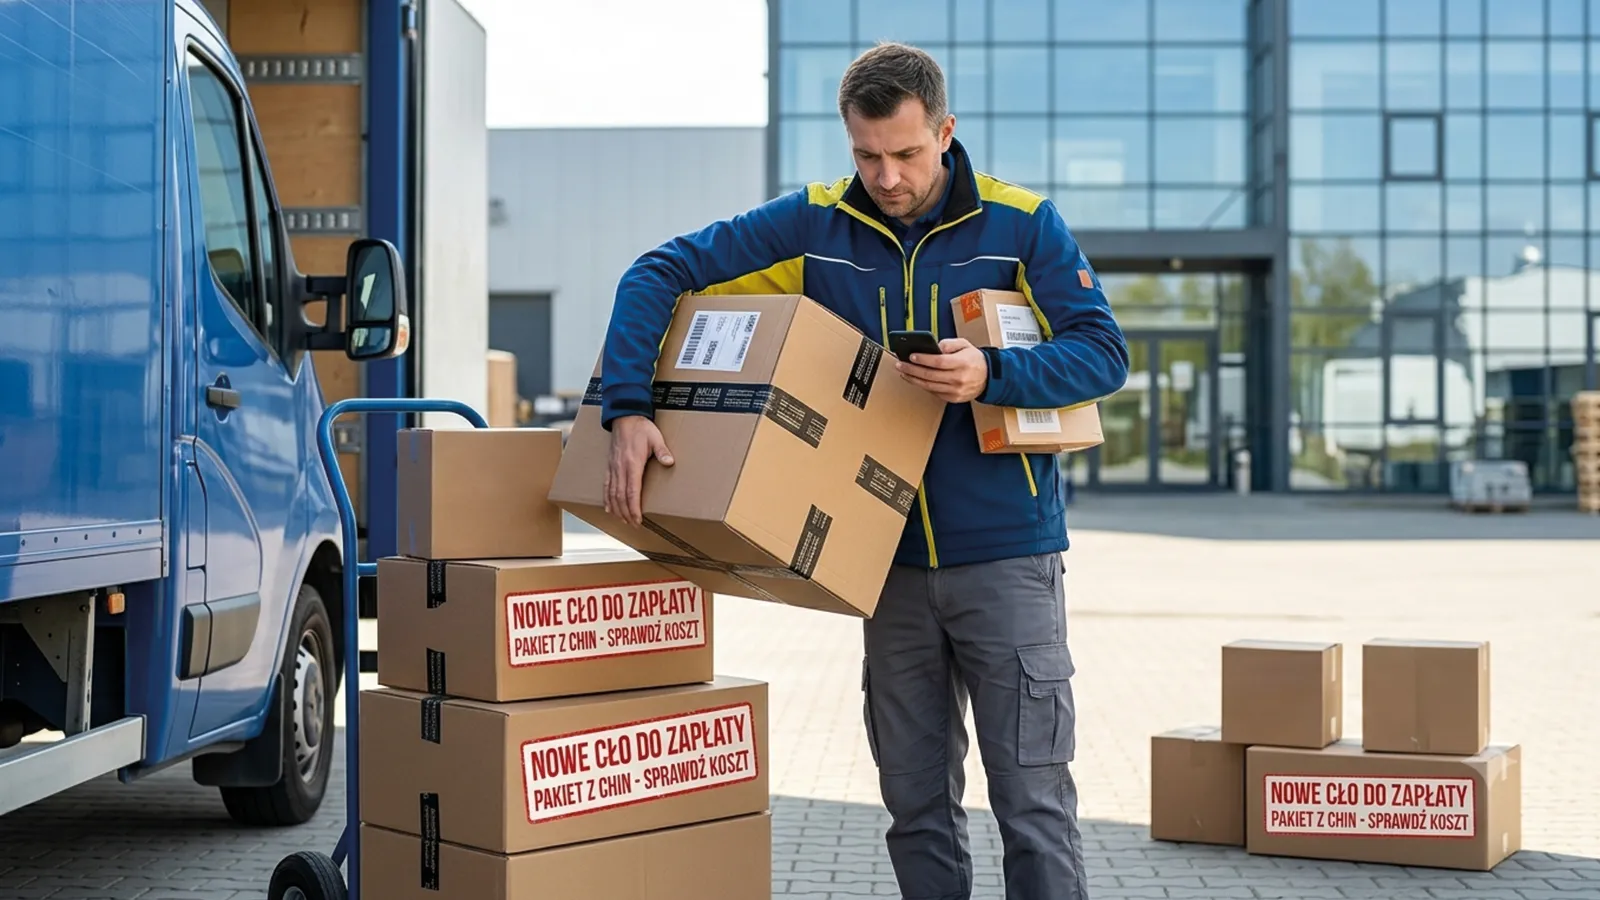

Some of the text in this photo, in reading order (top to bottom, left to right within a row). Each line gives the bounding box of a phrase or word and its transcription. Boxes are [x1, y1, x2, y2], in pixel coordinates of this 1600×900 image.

[512, 586, 697, 630] NOWE CŁO DO ZAPŁATY
[514, 634, 556, 657] PAKIET
[558, 633, 567, 653] Z
[568, 630, 597, 651] CHIN
[664, 619, 700, 642] KOSZT
[530, 713, 746, 781] NOWE CŁO DO ZAPŁATY
[533, 781, 583, 812] PAKIET
[586, 779, 595, 801] Z
[598, 773, 632, 799] CHIN
[643, 753, 708, 790] SPRAWDŹ
[709, 749, 750, 778] KOSZT
[1271, 781, 1468, 808] NOWE CŁO DO ZAPŁATY
[1271, 810, 1314, 828] PAKIET
[1316, 811, 1325, 828] Z
[1327, 811, 1357, 829] CHIN
[1368, 809, 1428, 830] SPRAWDŹ
[1430, 813, 1469, 831] KOSZT
